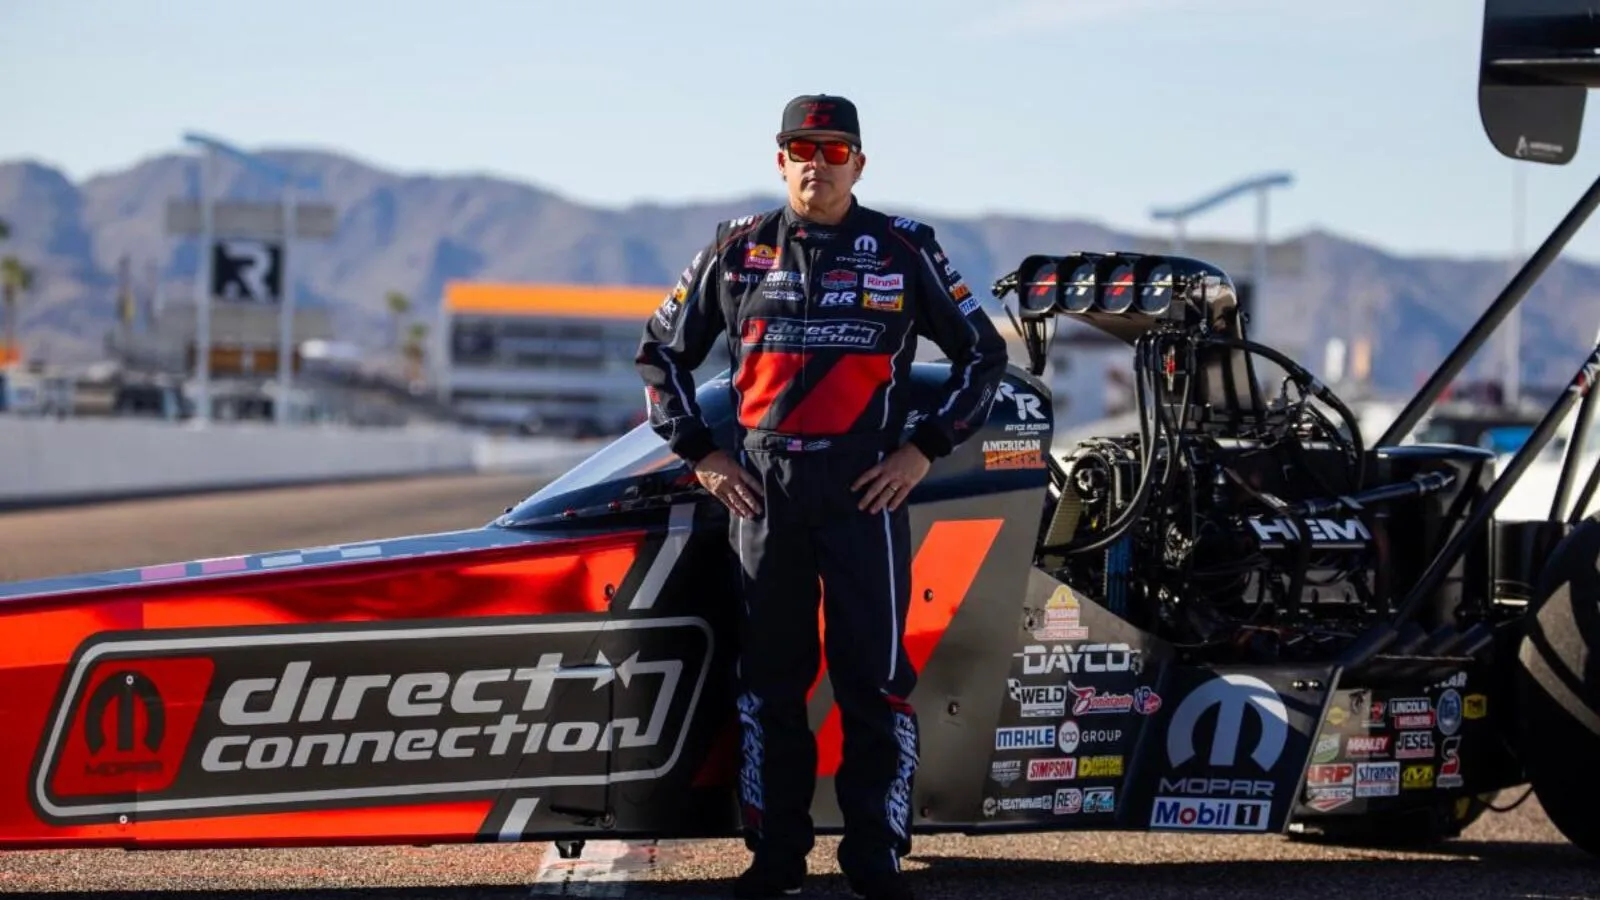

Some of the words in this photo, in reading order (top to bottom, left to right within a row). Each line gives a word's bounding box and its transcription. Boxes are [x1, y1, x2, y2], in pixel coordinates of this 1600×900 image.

[867, 277, 900, 287] Rinnai
[767, 321, 850, 335] direct
[763, 333, 872, 343] connection
[982, 440, 1041, 452] AMERICAN
[1248, 518, 1372, 541] HEM
[1023, 643, 1131, 675] DAYCO
[219, 652, 563, 725] direct
[1021, 688, 1064, 704] WELD
[201, 713, 655, 772] connection
[996, 729, 1055, 750] MAHLE
[1081, 730, 1122, 743] GROUP
[1397, 733, 1434, 749] JESEL
[1030, 761, 1074, 778] SIMPSON
[1159, 778, 1275, 796] MOPAR
[1155, 801, 1231, 826] Mobil
